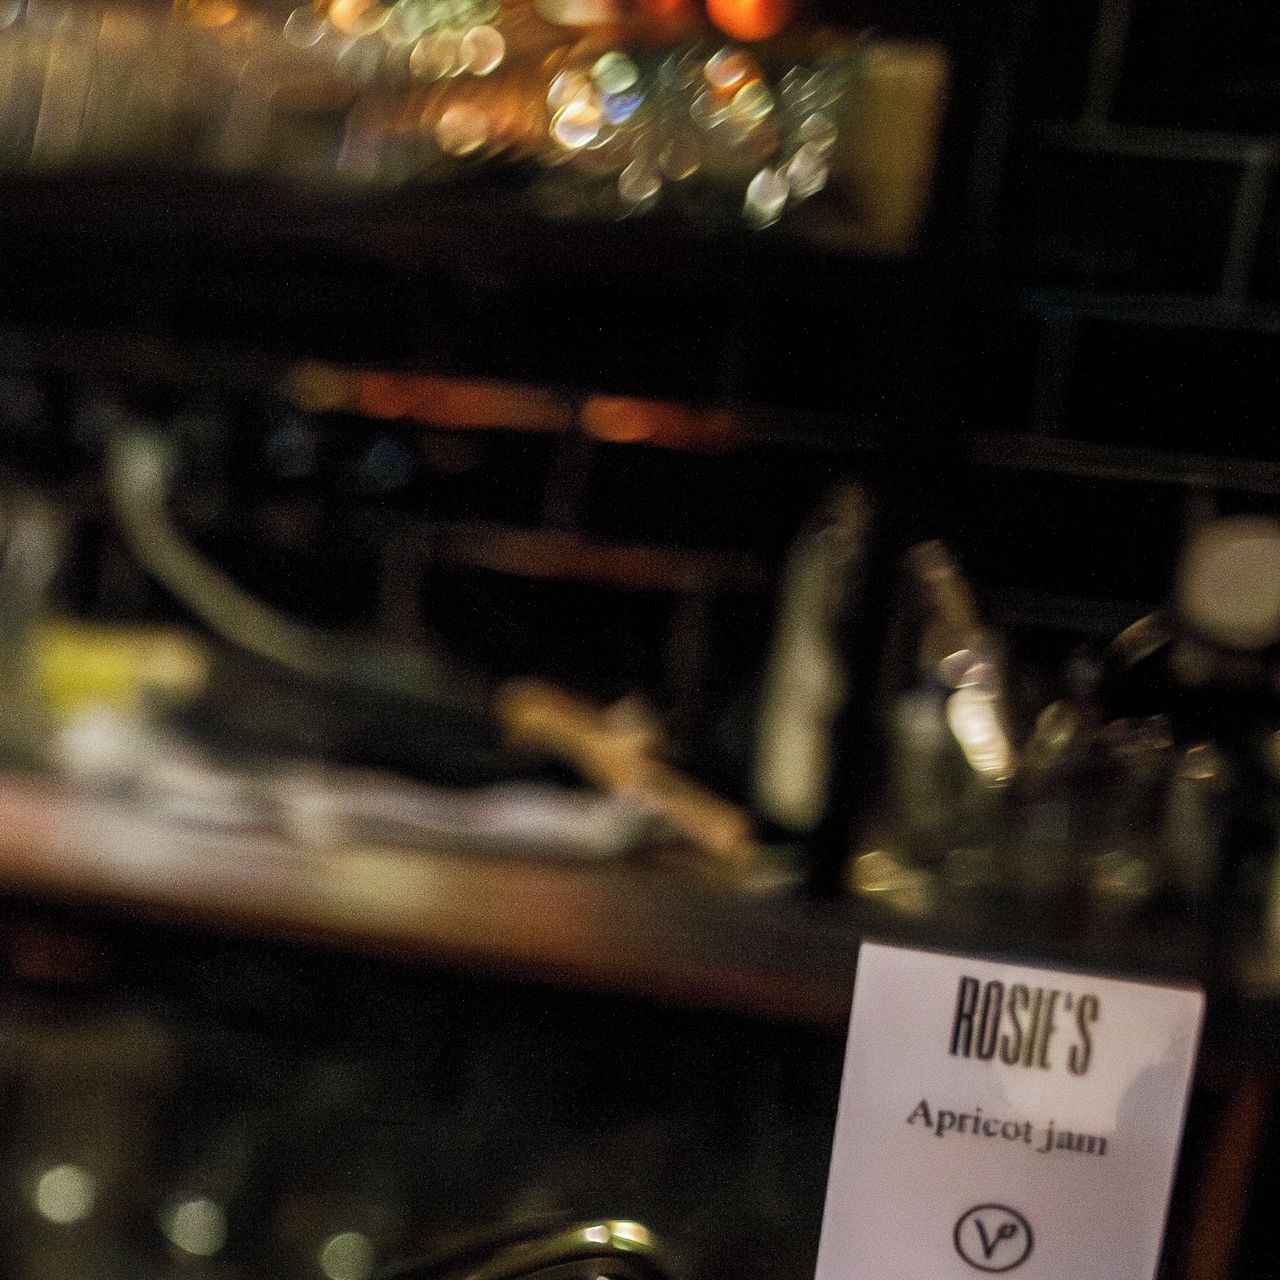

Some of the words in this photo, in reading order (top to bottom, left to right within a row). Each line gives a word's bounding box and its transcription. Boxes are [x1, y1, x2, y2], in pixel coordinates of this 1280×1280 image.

[950, 975, 1100, 1076] ROSIE'S
[906, 1098, 1033, 1145] Apricot
[1037, 1120, 1107, 1155] jam
